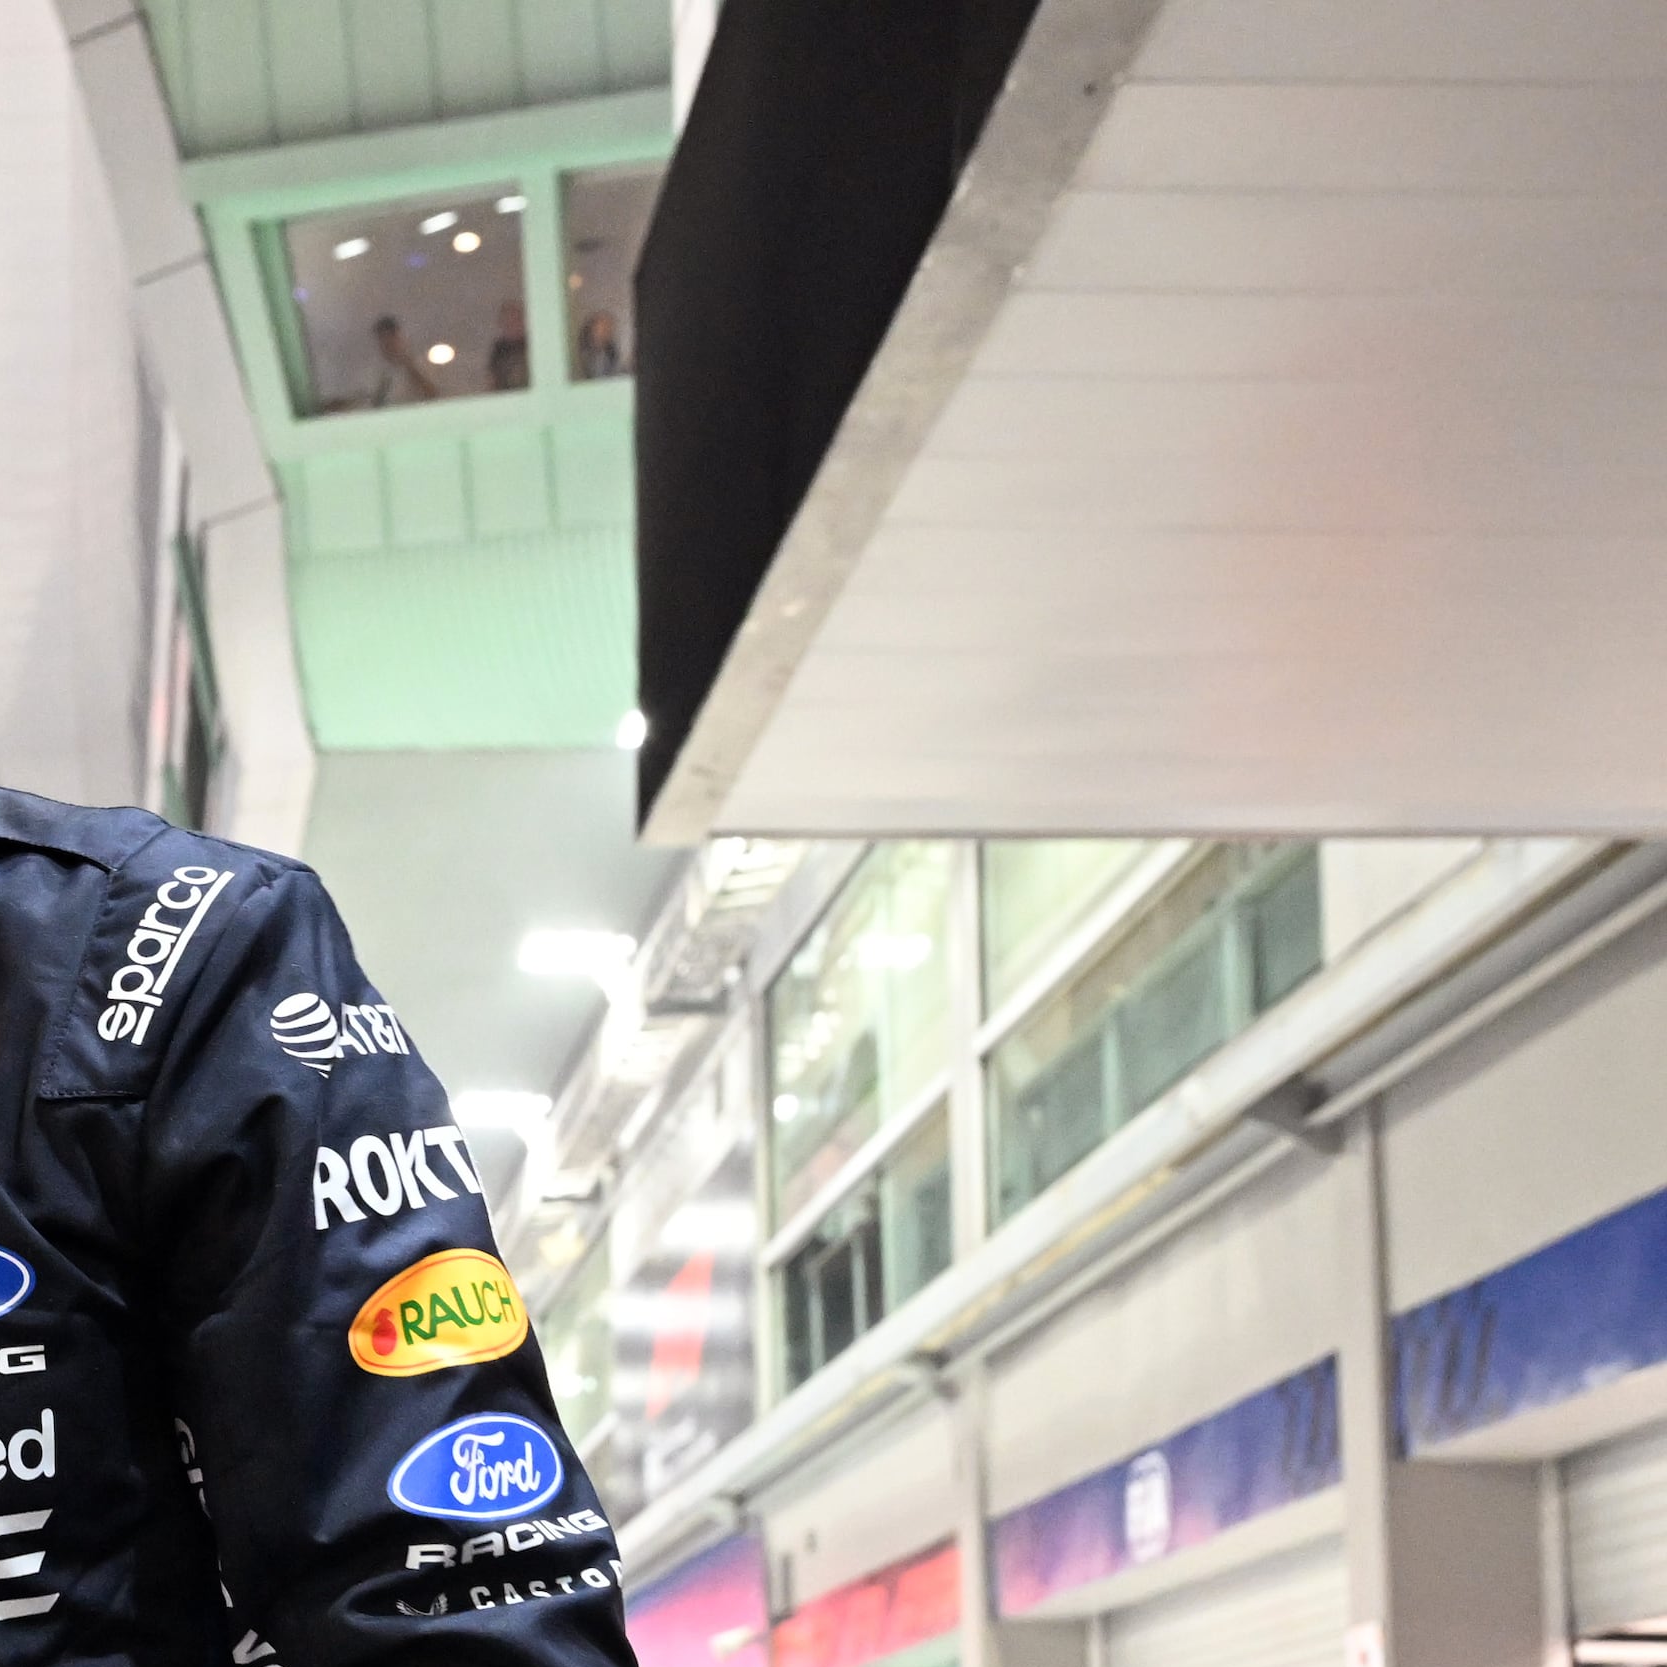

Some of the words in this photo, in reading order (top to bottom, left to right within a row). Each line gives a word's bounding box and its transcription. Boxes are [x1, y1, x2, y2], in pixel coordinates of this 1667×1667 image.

[98, 866, 235, 1046] sparco
[312, 1125, 483, 1231] ROKT
[400, 1280, 517, 1346] RAUCH
[450, 1431, 542, 1506] Ford
[405, 1509, 609, 1570] RACING
